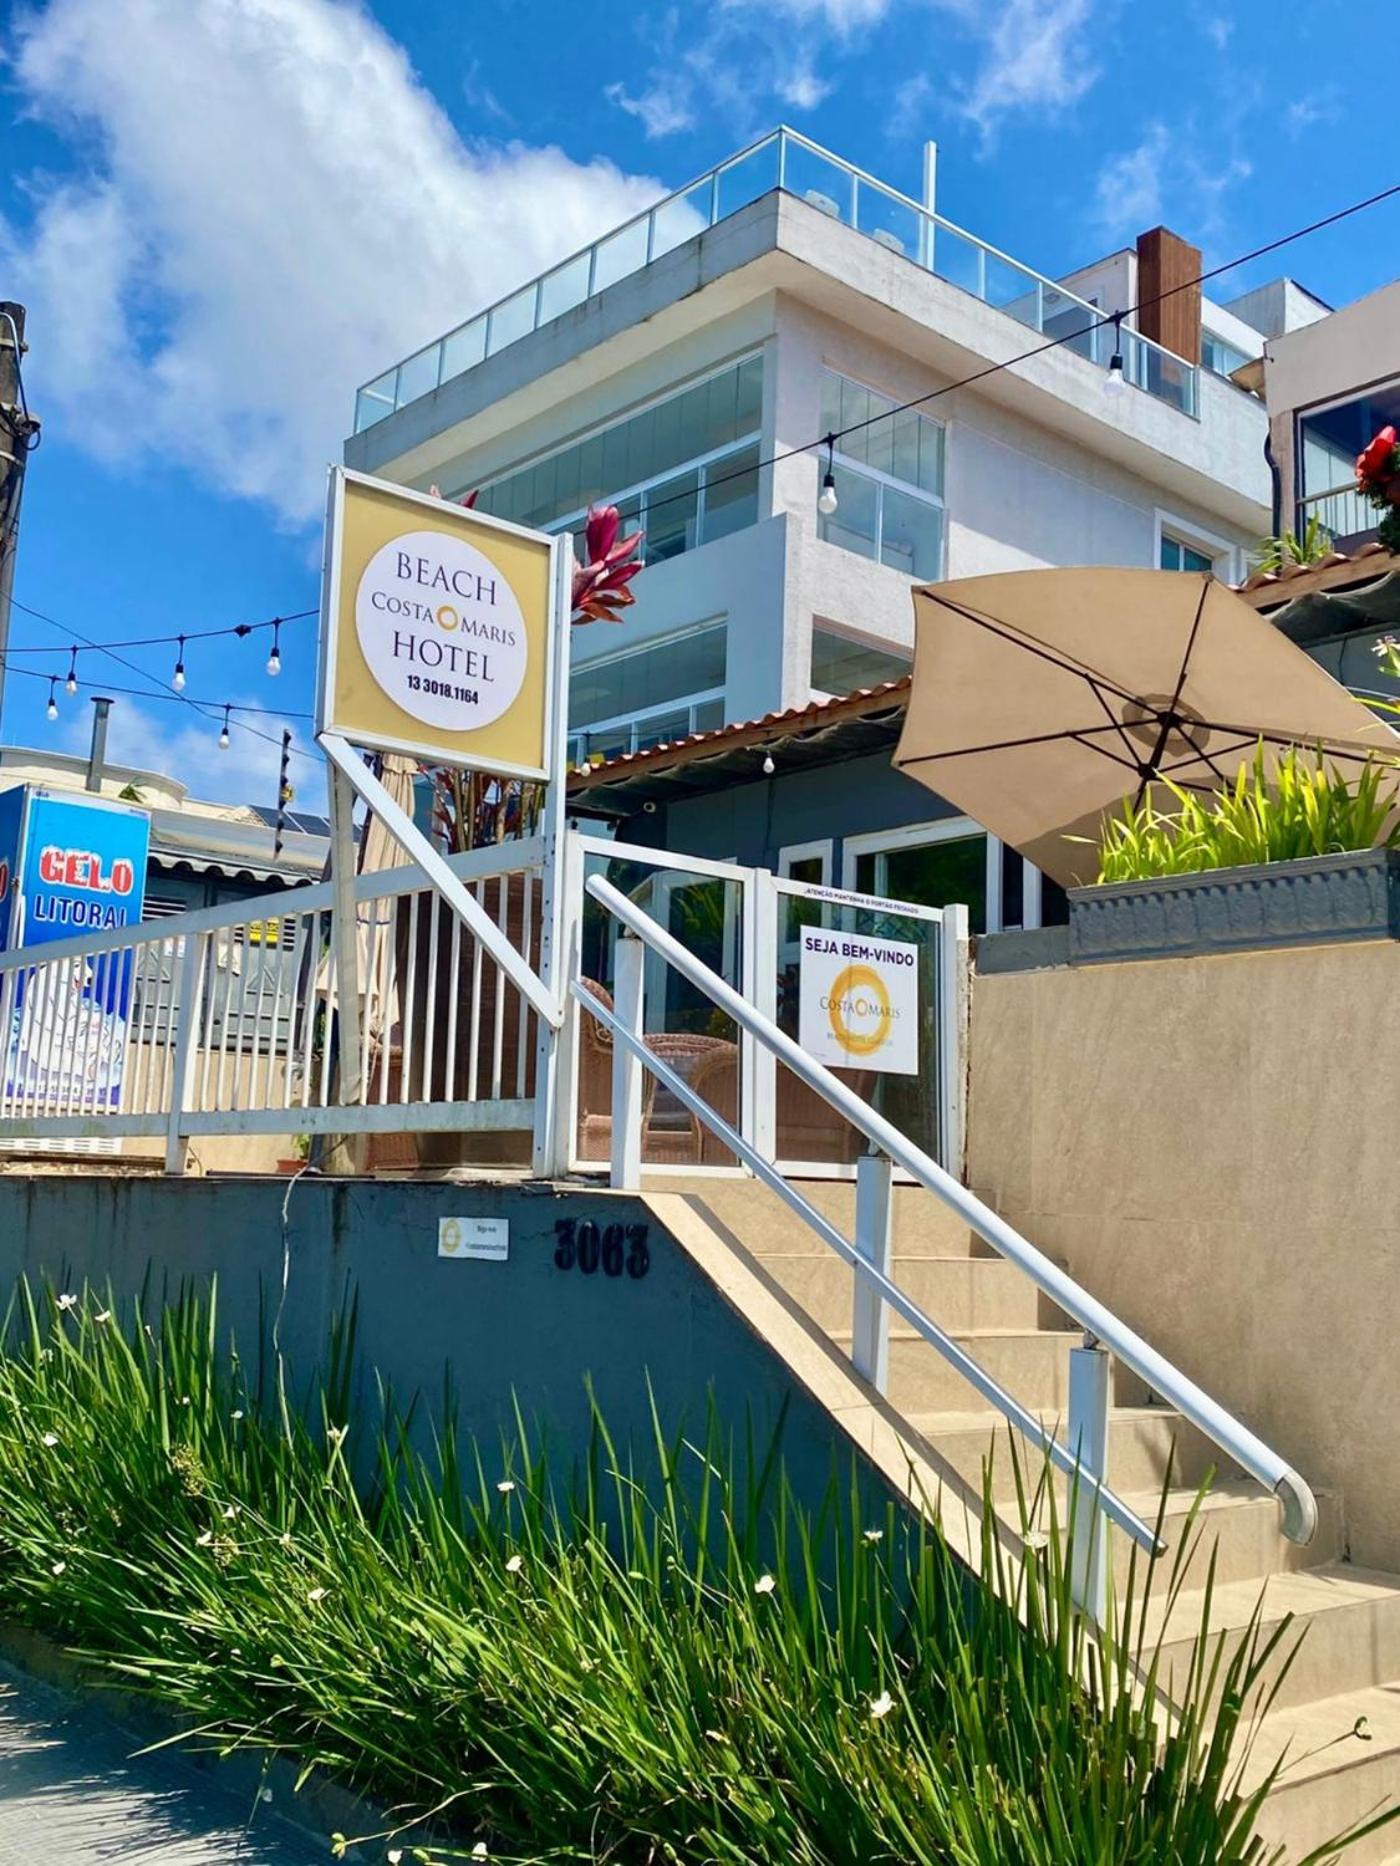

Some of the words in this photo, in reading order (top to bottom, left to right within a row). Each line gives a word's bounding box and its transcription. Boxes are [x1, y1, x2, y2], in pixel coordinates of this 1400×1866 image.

[397, 551, 497, 606] BEACH
[371, 591, 435, 624] COSTA
[460, 616, 517, 647] MARIS
[393, 630, 496, 683] HOTEL
[407, 674, 421, 691] 13
[423, 678, 479, 705] 3018.1164
[40, 847, 133, 894] GELO
[805, 937, 839, 955] SEJA
[842, 943, 915, 966] BEM-VINDO
[554, 1218, 650, 1279] 3063
